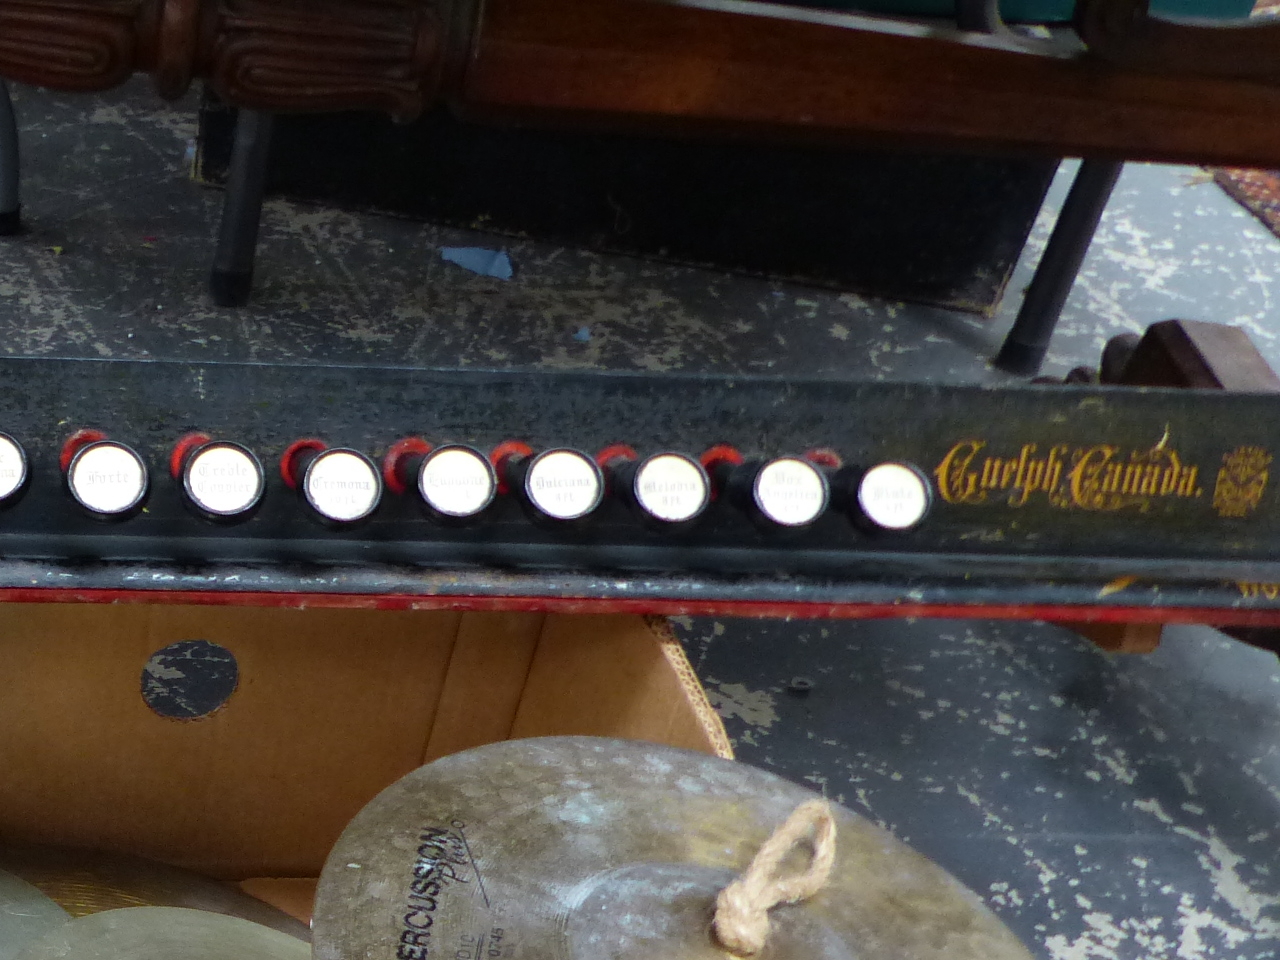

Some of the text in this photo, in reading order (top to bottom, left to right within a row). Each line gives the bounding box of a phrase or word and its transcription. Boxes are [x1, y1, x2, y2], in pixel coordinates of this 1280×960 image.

[85, 469, 130, 485] Forte
[198, 462, 248, 477] Treble
[312, 476, 371, 491] Cremona
[535, 475, 592, 490] Dulciana
[643, 480, 697, 495] Melodia
